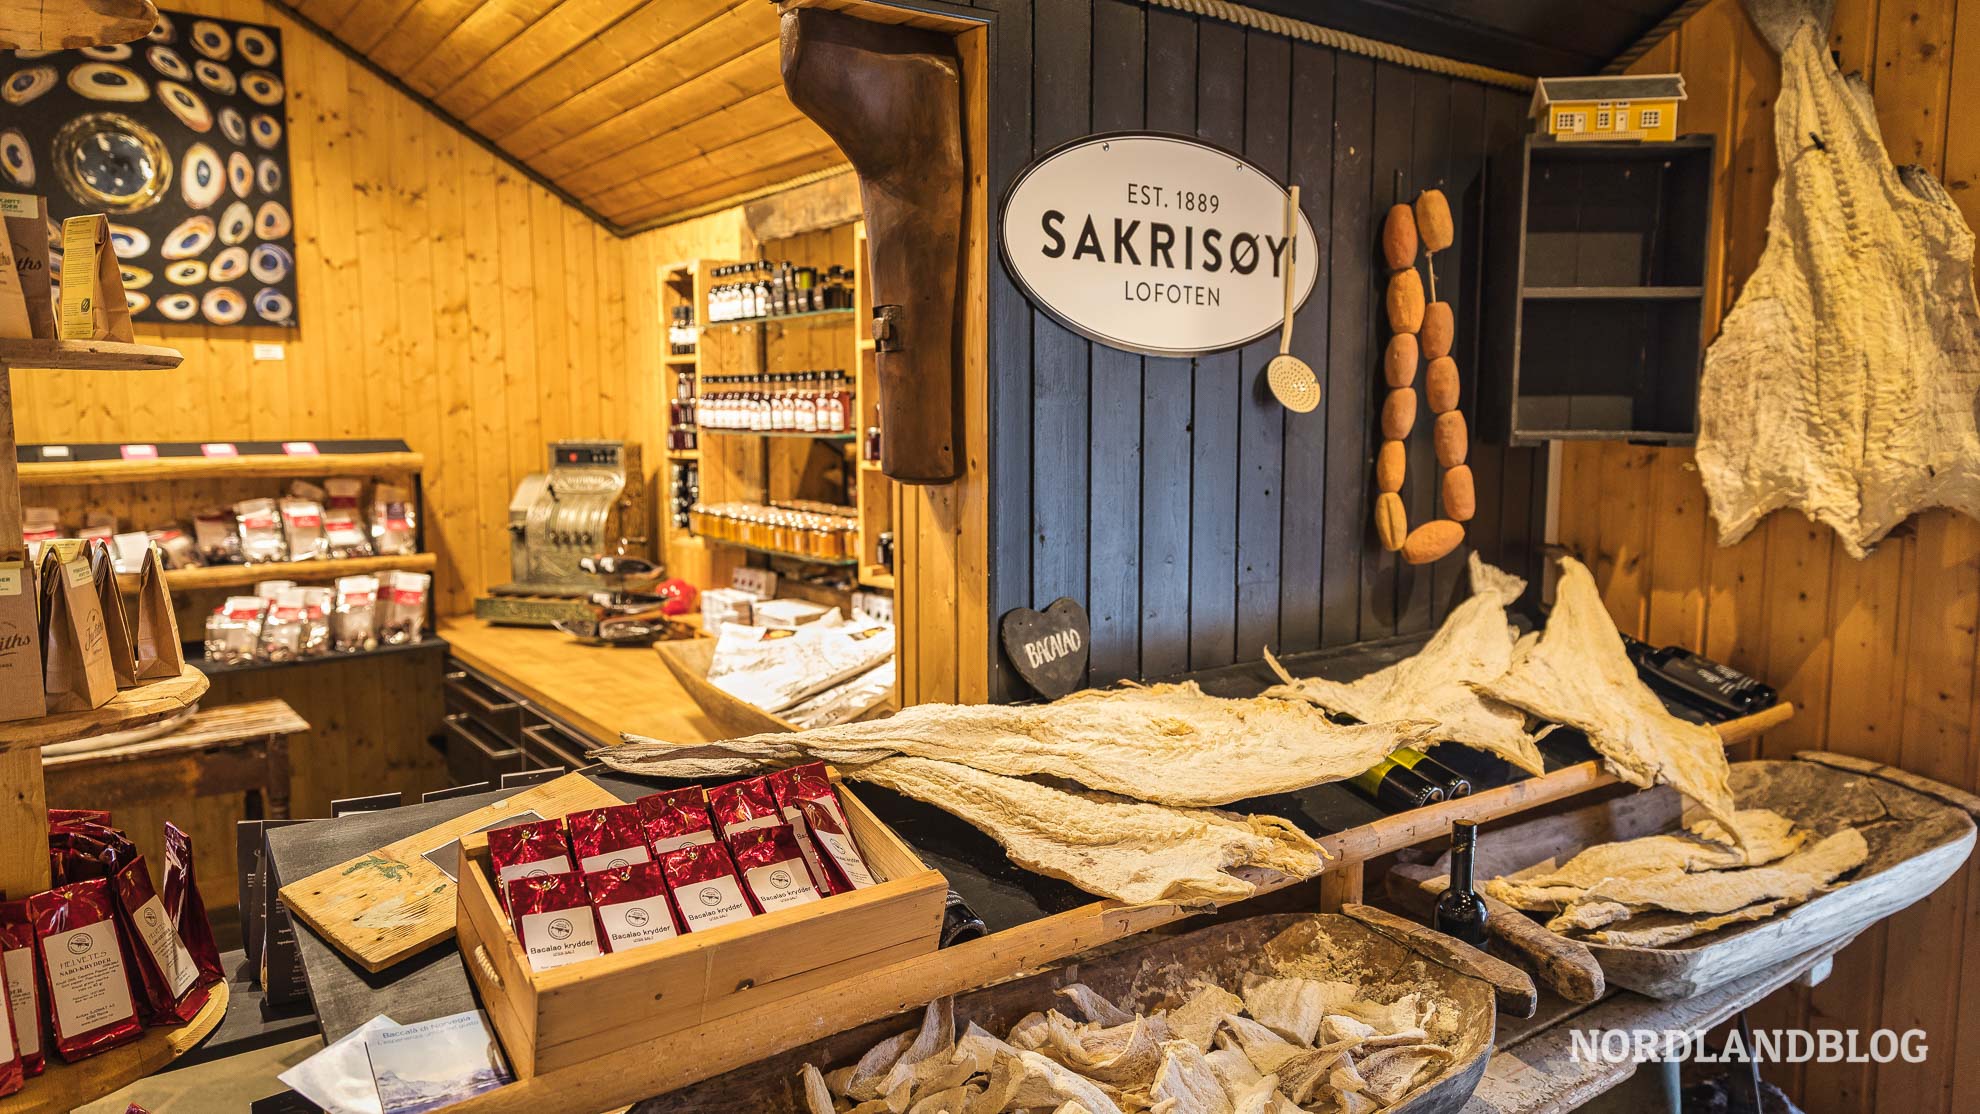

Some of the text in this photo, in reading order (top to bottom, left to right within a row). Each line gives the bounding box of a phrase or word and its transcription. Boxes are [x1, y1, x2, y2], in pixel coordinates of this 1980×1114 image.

[1127, 183, 1219, 214] EST. 1889
[1041, 209, 1289, 277] SAKRISØY
[1125, 280, 1220, 307] LOFOTEN
[1024, 628, 1081, 669] BACALAO
[760, 886, 811, 902] Bacalao krydder
[688, 902, 743, 921] Bacalao krydder
[611, 925, 671, 941] Bacalao krydder
[530, 939, 594, 955] Bacalao krydder
[59, 957, 111, 977] NABO-KRYDDER
